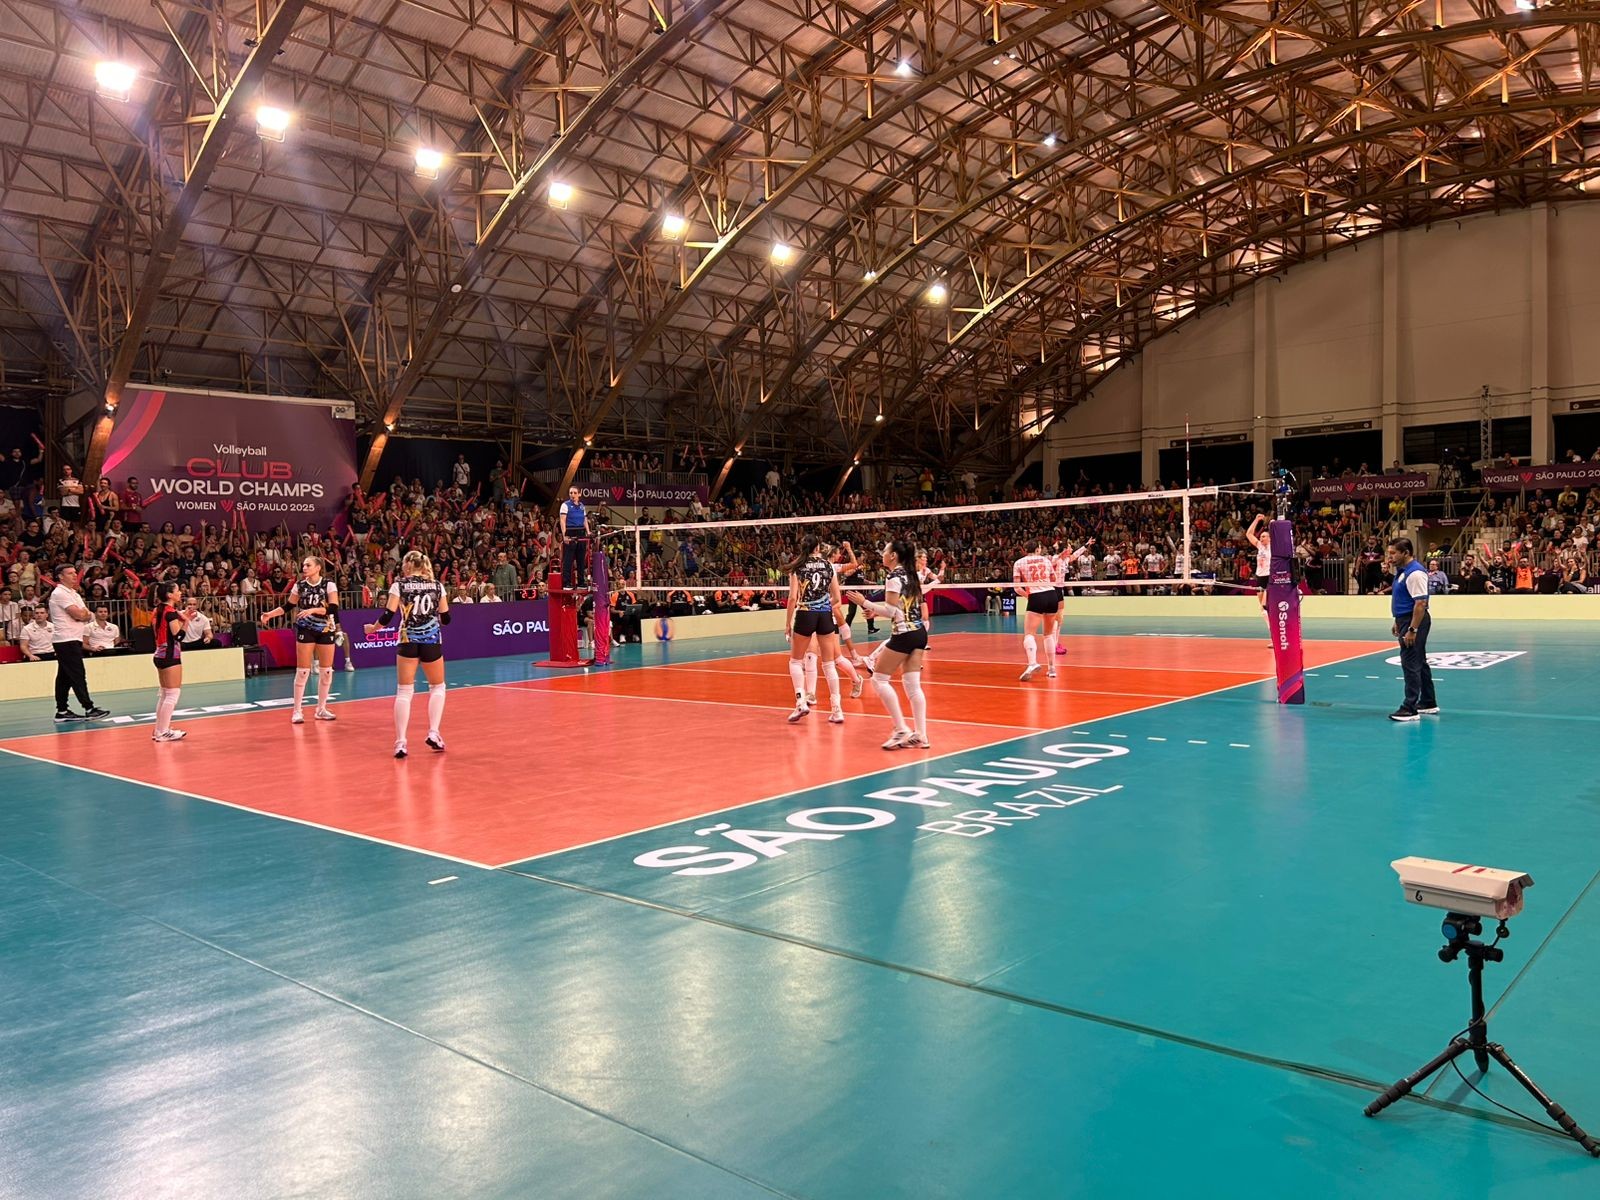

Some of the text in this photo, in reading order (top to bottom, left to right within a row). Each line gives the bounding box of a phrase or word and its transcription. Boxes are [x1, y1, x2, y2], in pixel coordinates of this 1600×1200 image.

[213, 443, 267, 457] Volleyball
[186, 457, 293, 480] CLUB
[1483, 475, 1519, 484] WOMEN
[1556, 470, 1586, 479] PAULO
[150, 478, 324, 498] WORLD CHAMPS
[646, 490, 674, 500] PAULO
[1312, 485, 1343, 493] WOMEN
[1374, 481, 1401, 490] PAULO
[1402, 480, 1425, 488] 2025
[175, 501, 315, 512] WOMEN SÃO PAULO 2025
[1028, 563, 1047, 581] 22
[811, 571, 821, 591] 9
[308, 593, 320, 606] 13
[412, 593, 432, 615] 10
[492, 620, 523, 636] SÃO
[1278, 611, 1290, 651] Senoh
[353, 640, 384, 649] WORLD
[632, 742, 1130, 876] SÃO PAULO
[915, 784, 1124, 838] BRAZIL
